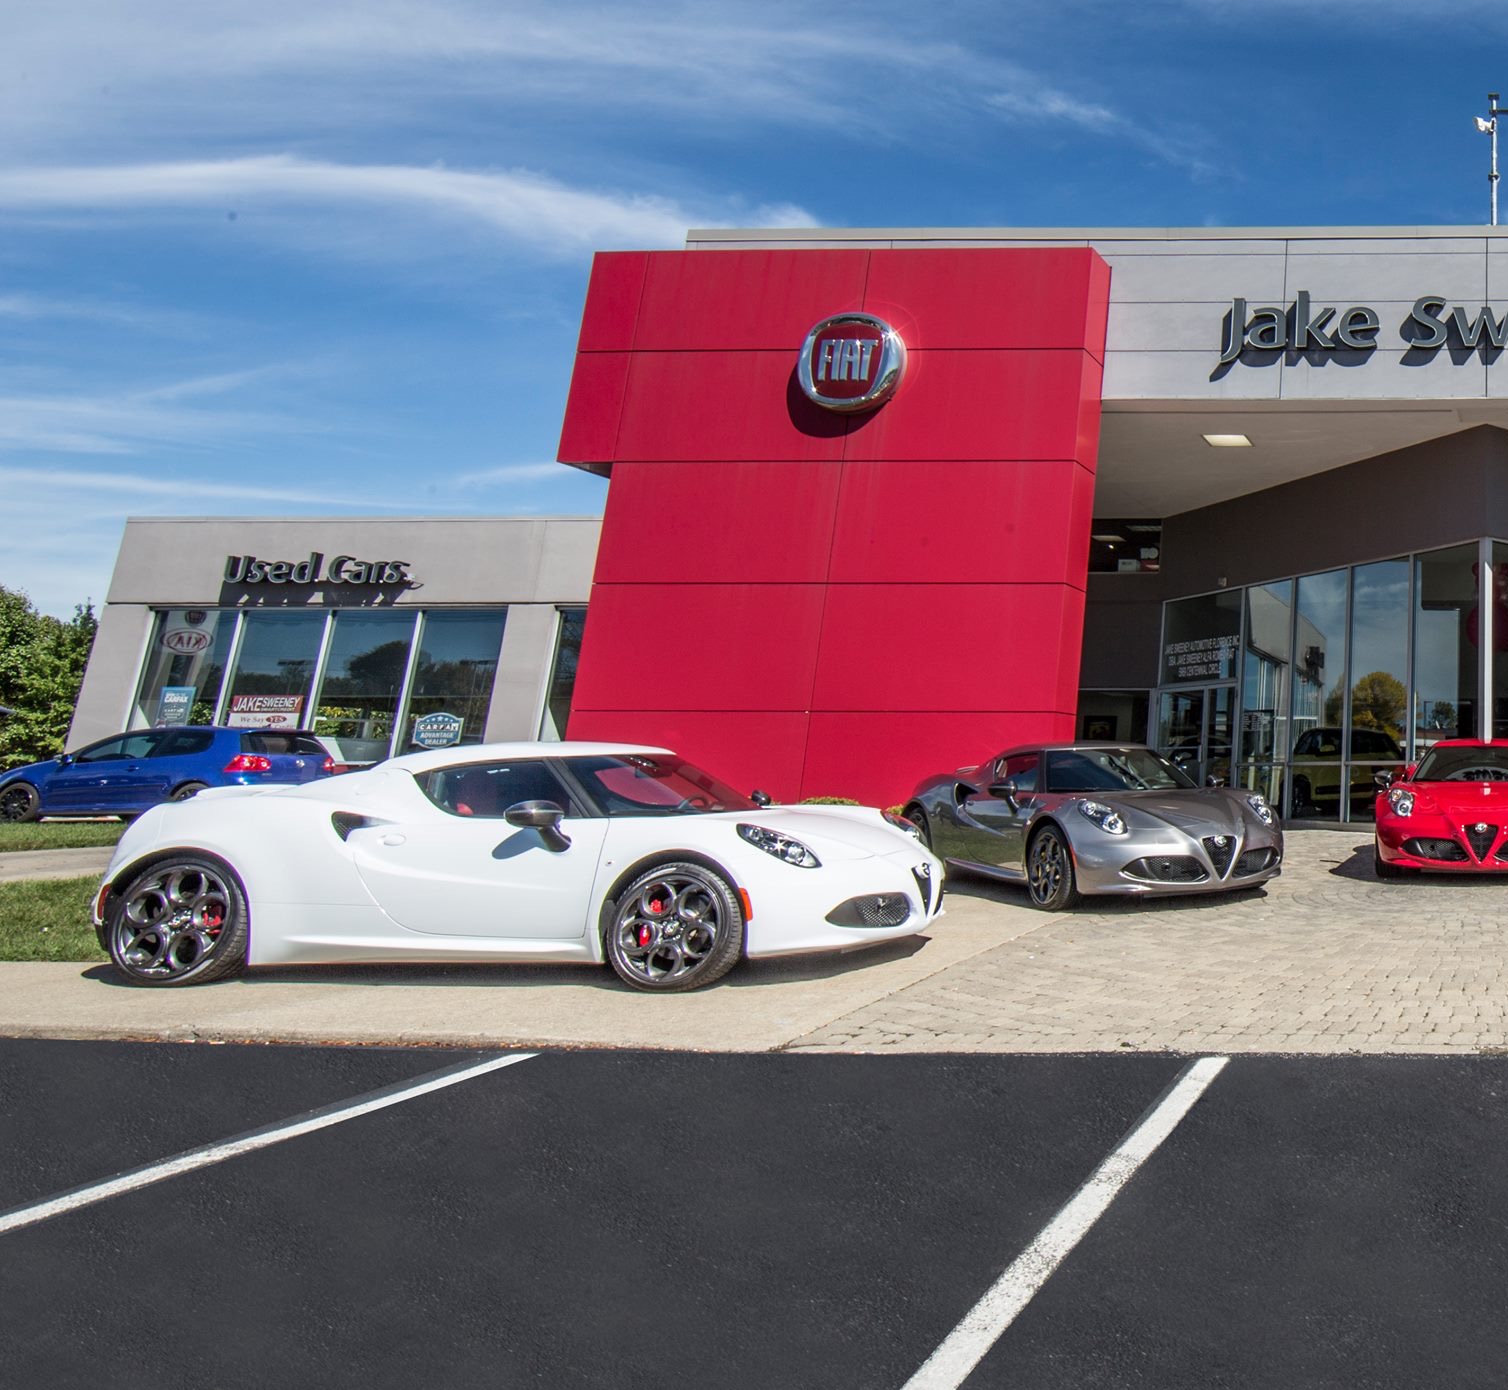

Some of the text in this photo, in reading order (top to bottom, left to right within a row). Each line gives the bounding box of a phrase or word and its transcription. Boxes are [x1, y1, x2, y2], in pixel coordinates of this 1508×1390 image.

[1219, 290, 1381, 364] Jake
[817, 339, 879, 381] FIAT
[223, 551, 411, 584] Used Cars
[233, 697, 301, 712] JAKE SWEENEY
